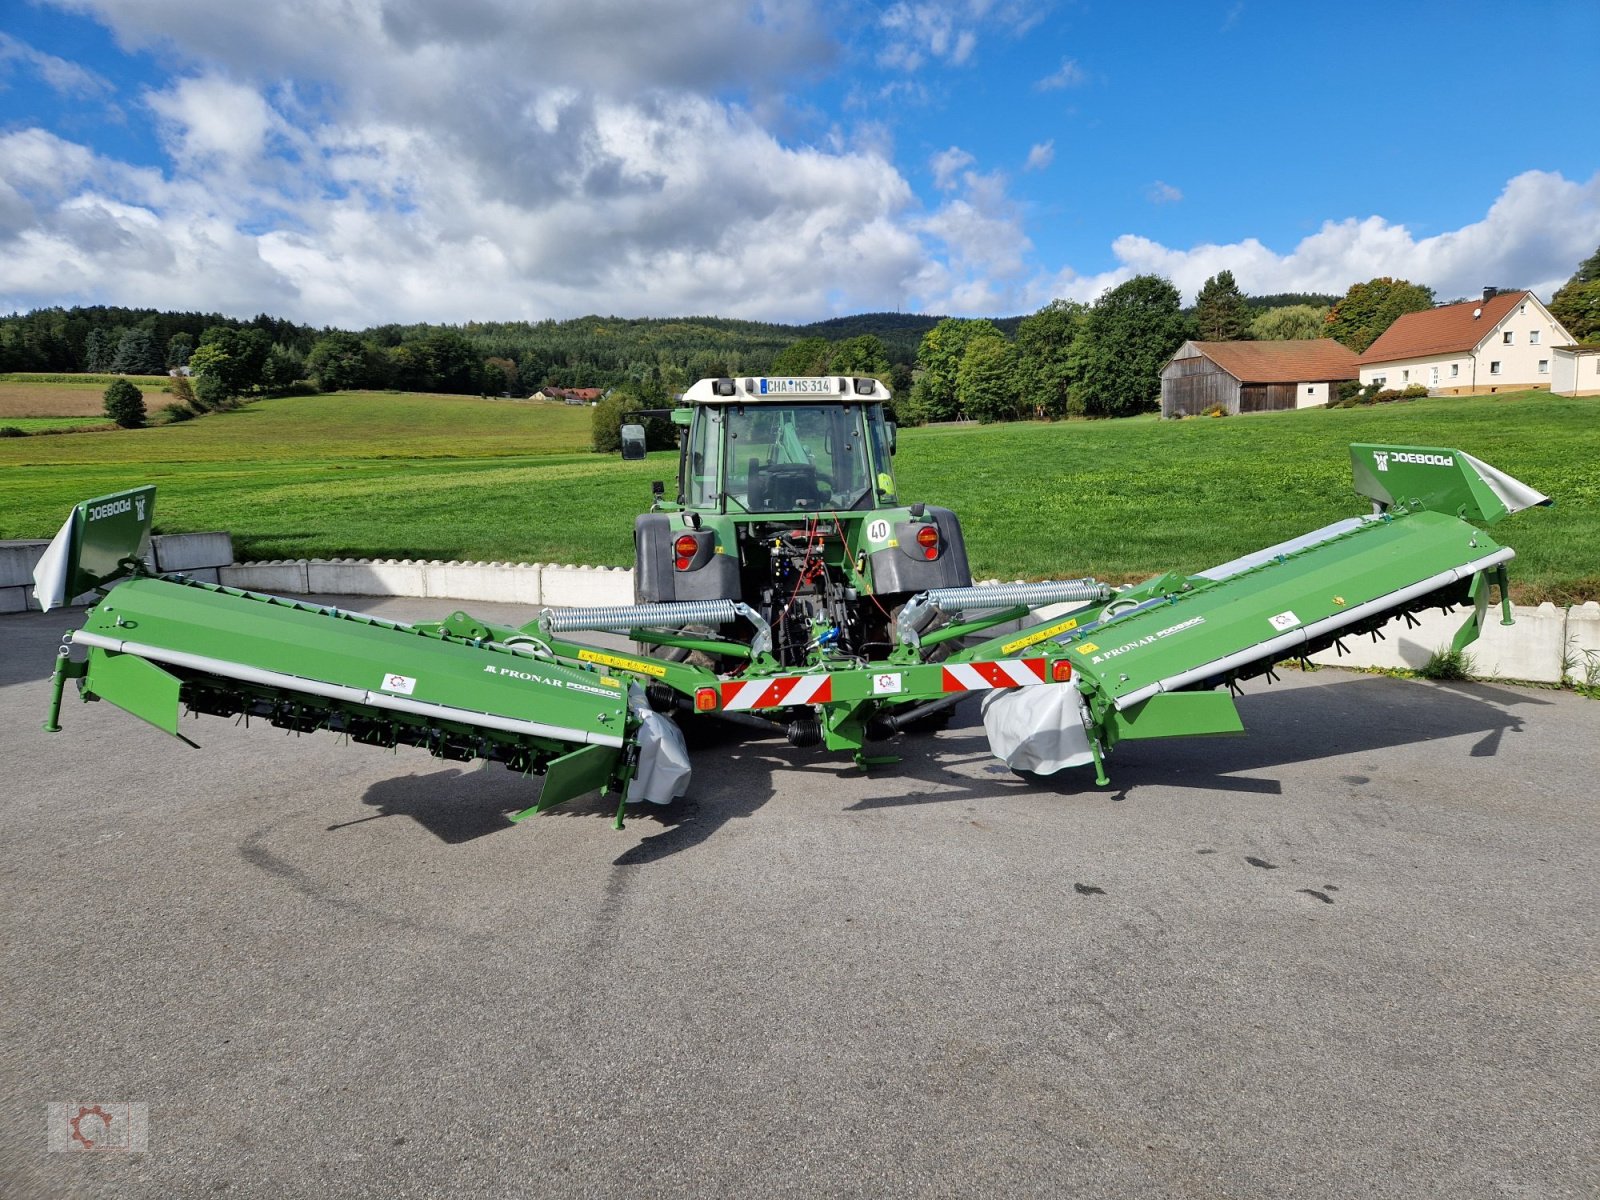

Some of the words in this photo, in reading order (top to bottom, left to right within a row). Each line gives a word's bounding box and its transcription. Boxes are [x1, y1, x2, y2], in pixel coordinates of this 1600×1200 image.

[767, 380, 787, 392] CHA
[810, 380, 829, 392] 314
[1390, 451, 1454, 467] PDD830C
[871, 522, 886, 539] 40
[1103, 635, 1158, 660] PRONAR
[499, 667, 563, 688] PRONAR
